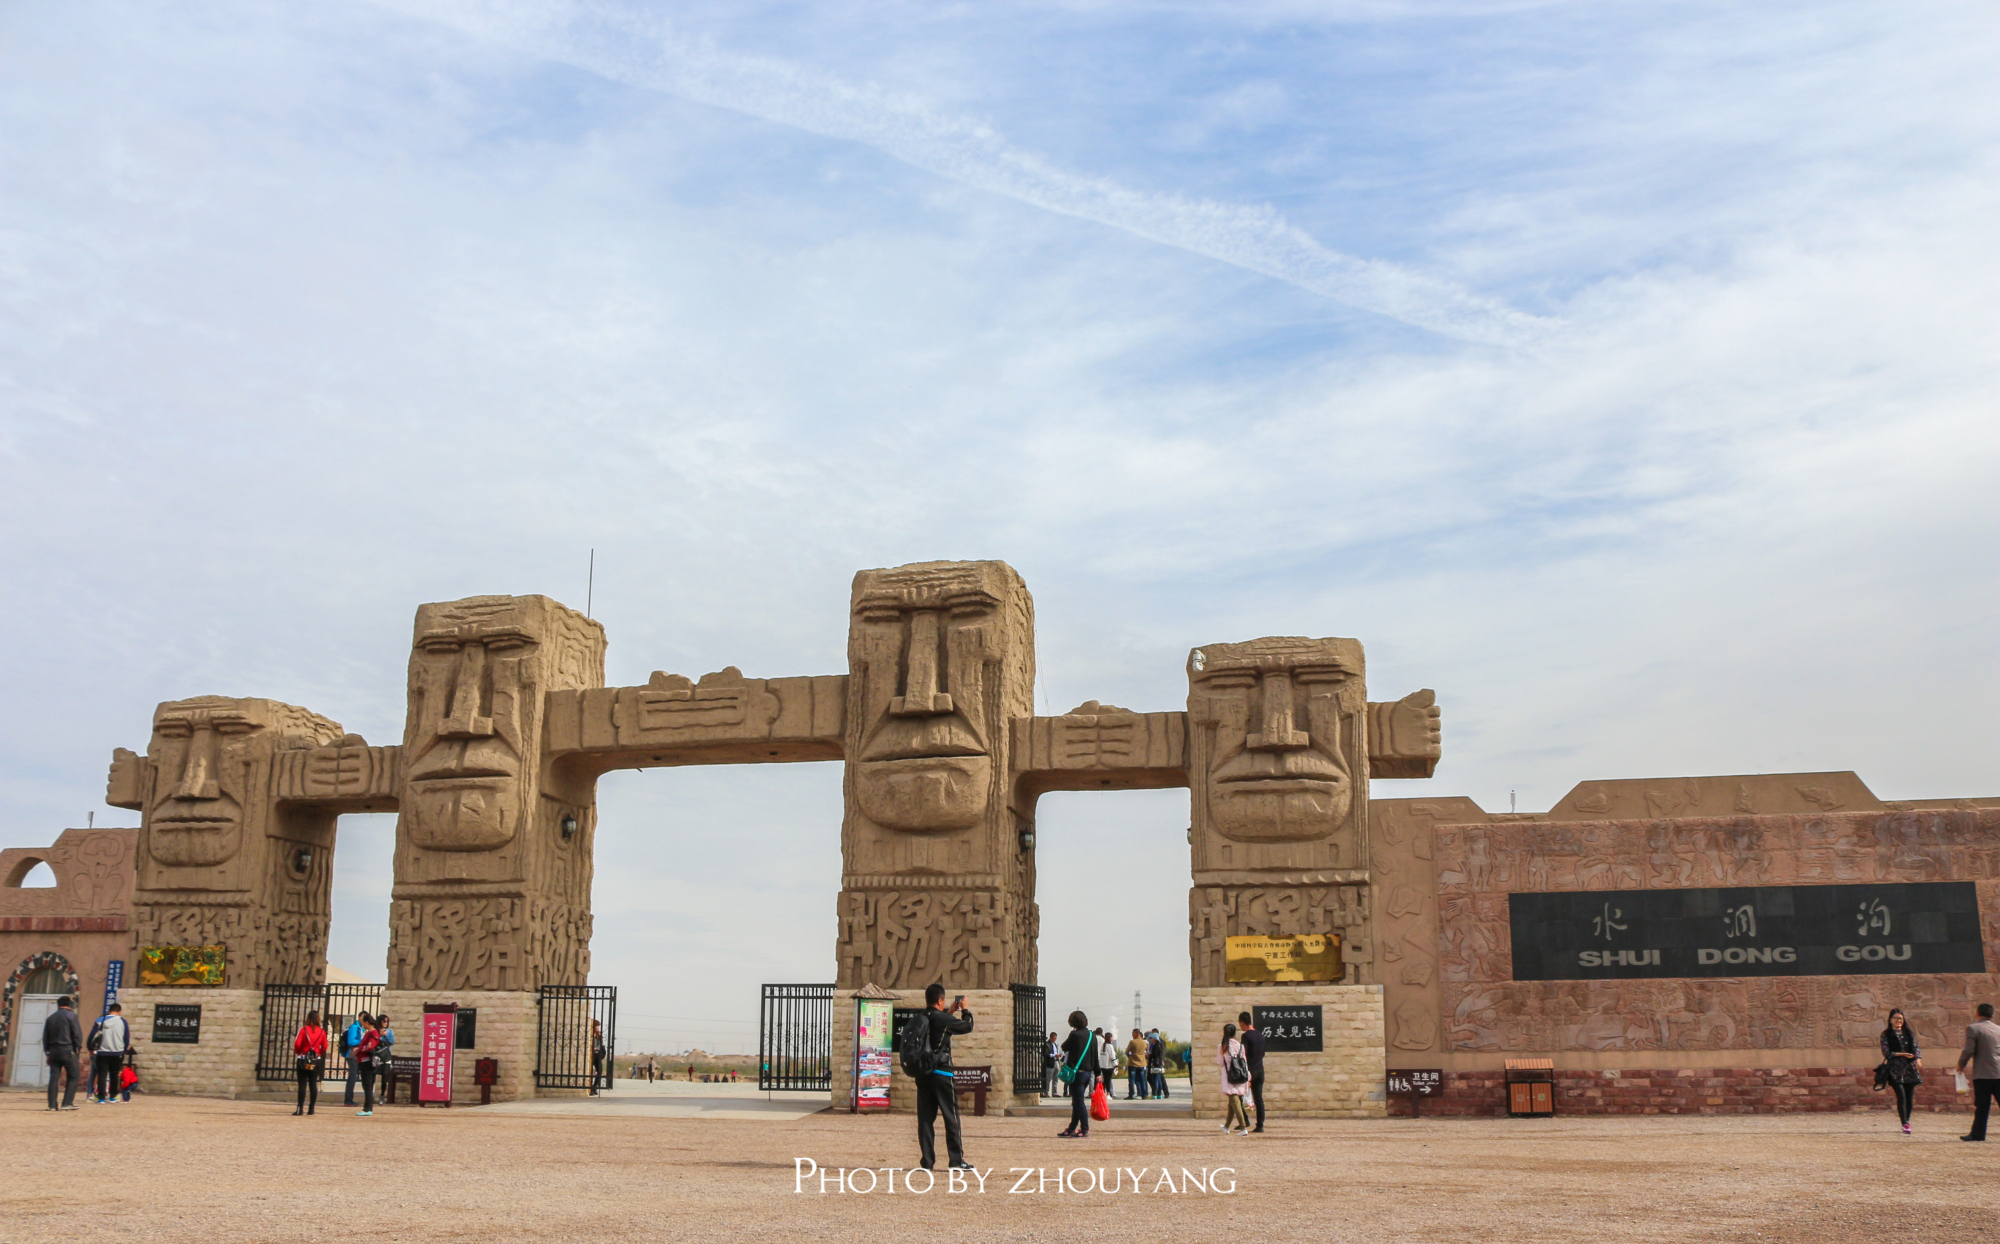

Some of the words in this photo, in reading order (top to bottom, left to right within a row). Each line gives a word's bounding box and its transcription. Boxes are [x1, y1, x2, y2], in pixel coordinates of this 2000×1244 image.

[1593, 898, 1891, 941] 水洞沟
[1578, 950, 1661, 967] SHUI
[1697, 946, 1797, 965] DONG
[1836, 944, 1912, 962] GOU
[156, 1017, 198, 1028] 水洞沟遗址
[1261, 1011, 1314, 1019] 中西文化交流的
[1261, 1024, 1317, 1039] 历史见证
[426, 1032, 438, 1085] 十佳旅游景区
[1412, 1072, 1439, 1081] 卫生间
